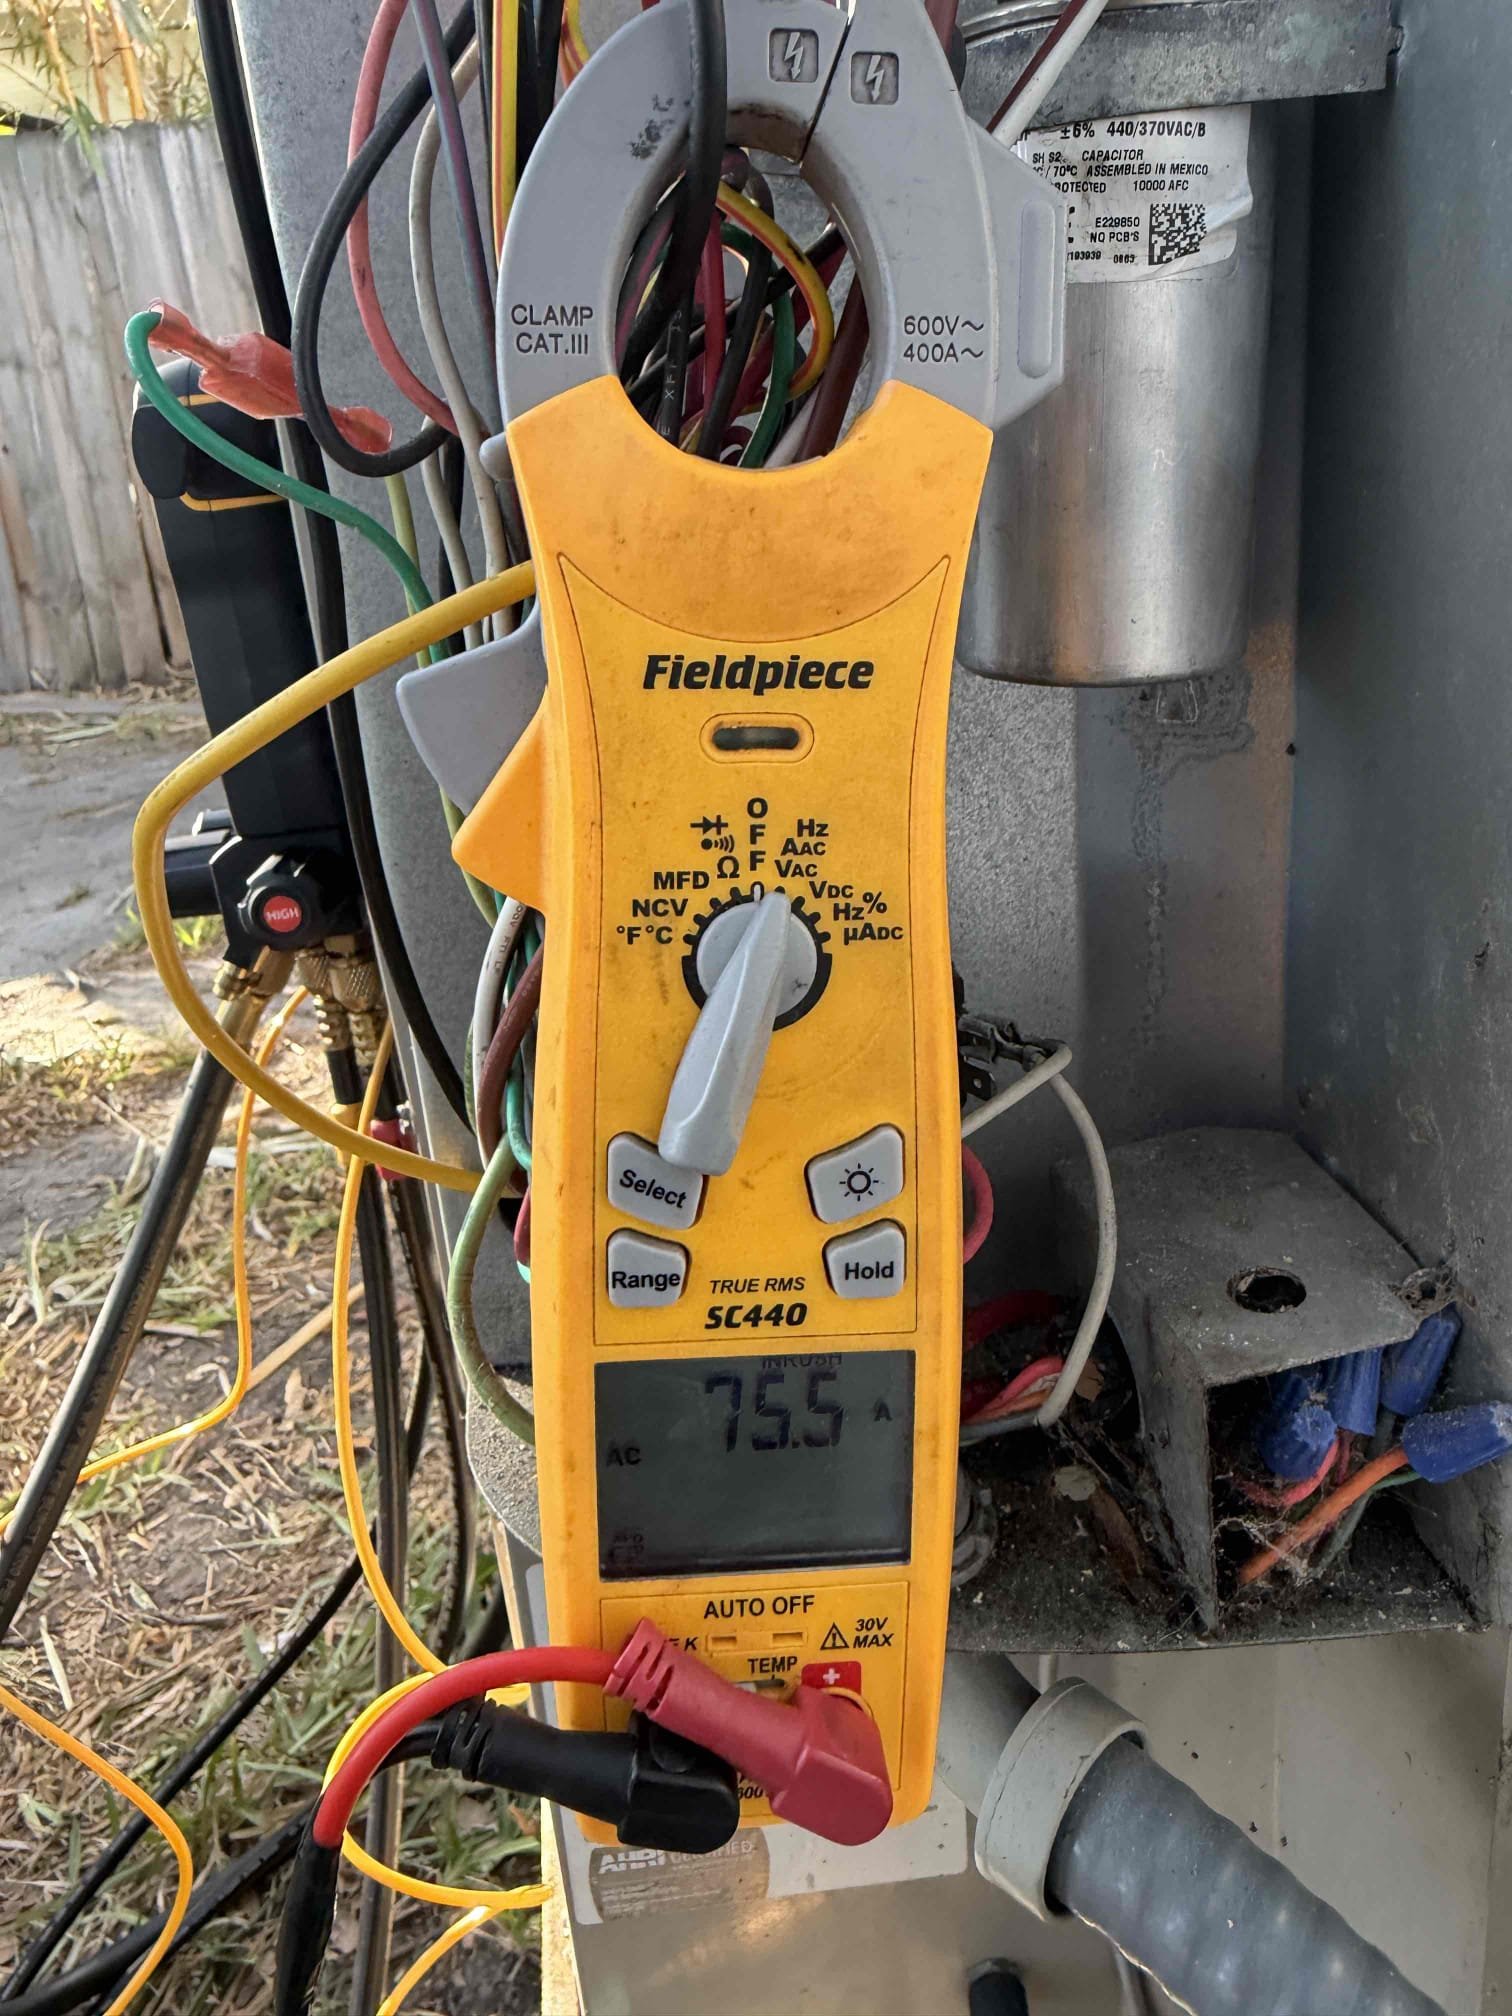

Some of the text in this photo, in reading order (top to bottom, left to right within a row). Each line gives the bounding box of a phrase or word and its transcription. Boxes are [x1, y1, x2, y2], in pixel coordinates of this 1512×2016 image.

[1106, 120, 1206, 139] 440/370VAC/B
[1082, 149, 1144, 162] CAPACITOR
[1086, 163, 1151, 177] ASSEMBLED
[1155, 163, 1166, 175] IN
[1170, 163, 1208, 175] MEXICO
[1052, 180, 1189, 193] ROTECTED 10000 AFC
[1095, 216, 1140, 228] E229850
[511, 304, 594, 327] CLAMP
[516, 331, 589, 355] CAT.III
[643, 654, 874, 696] Fieldpiece
[797, 819, 829, 837] Hz
[653, 871, 710, 890] MFD
[631, 898, 689, 917] NCV
[619, 1169, 688, 1209] Select
[844, 1261, 894, 1280] Hold
[612, 1270, 681, 1291] Range
[710, 1277, 806, 1294] TRUE RMS
[704, 1302, 808, 1330] SC440
[704, 1372, 893, 1452] 75.5 A
[605, 1446, 641, 1466] AC
[703, 1595, 815, 1619] AUTO OFF
[855, 1617, 889, 1632] 30V
[853, 1633, 895, 1649] MAX
[748, 1656, 798, 1674] TEMP
